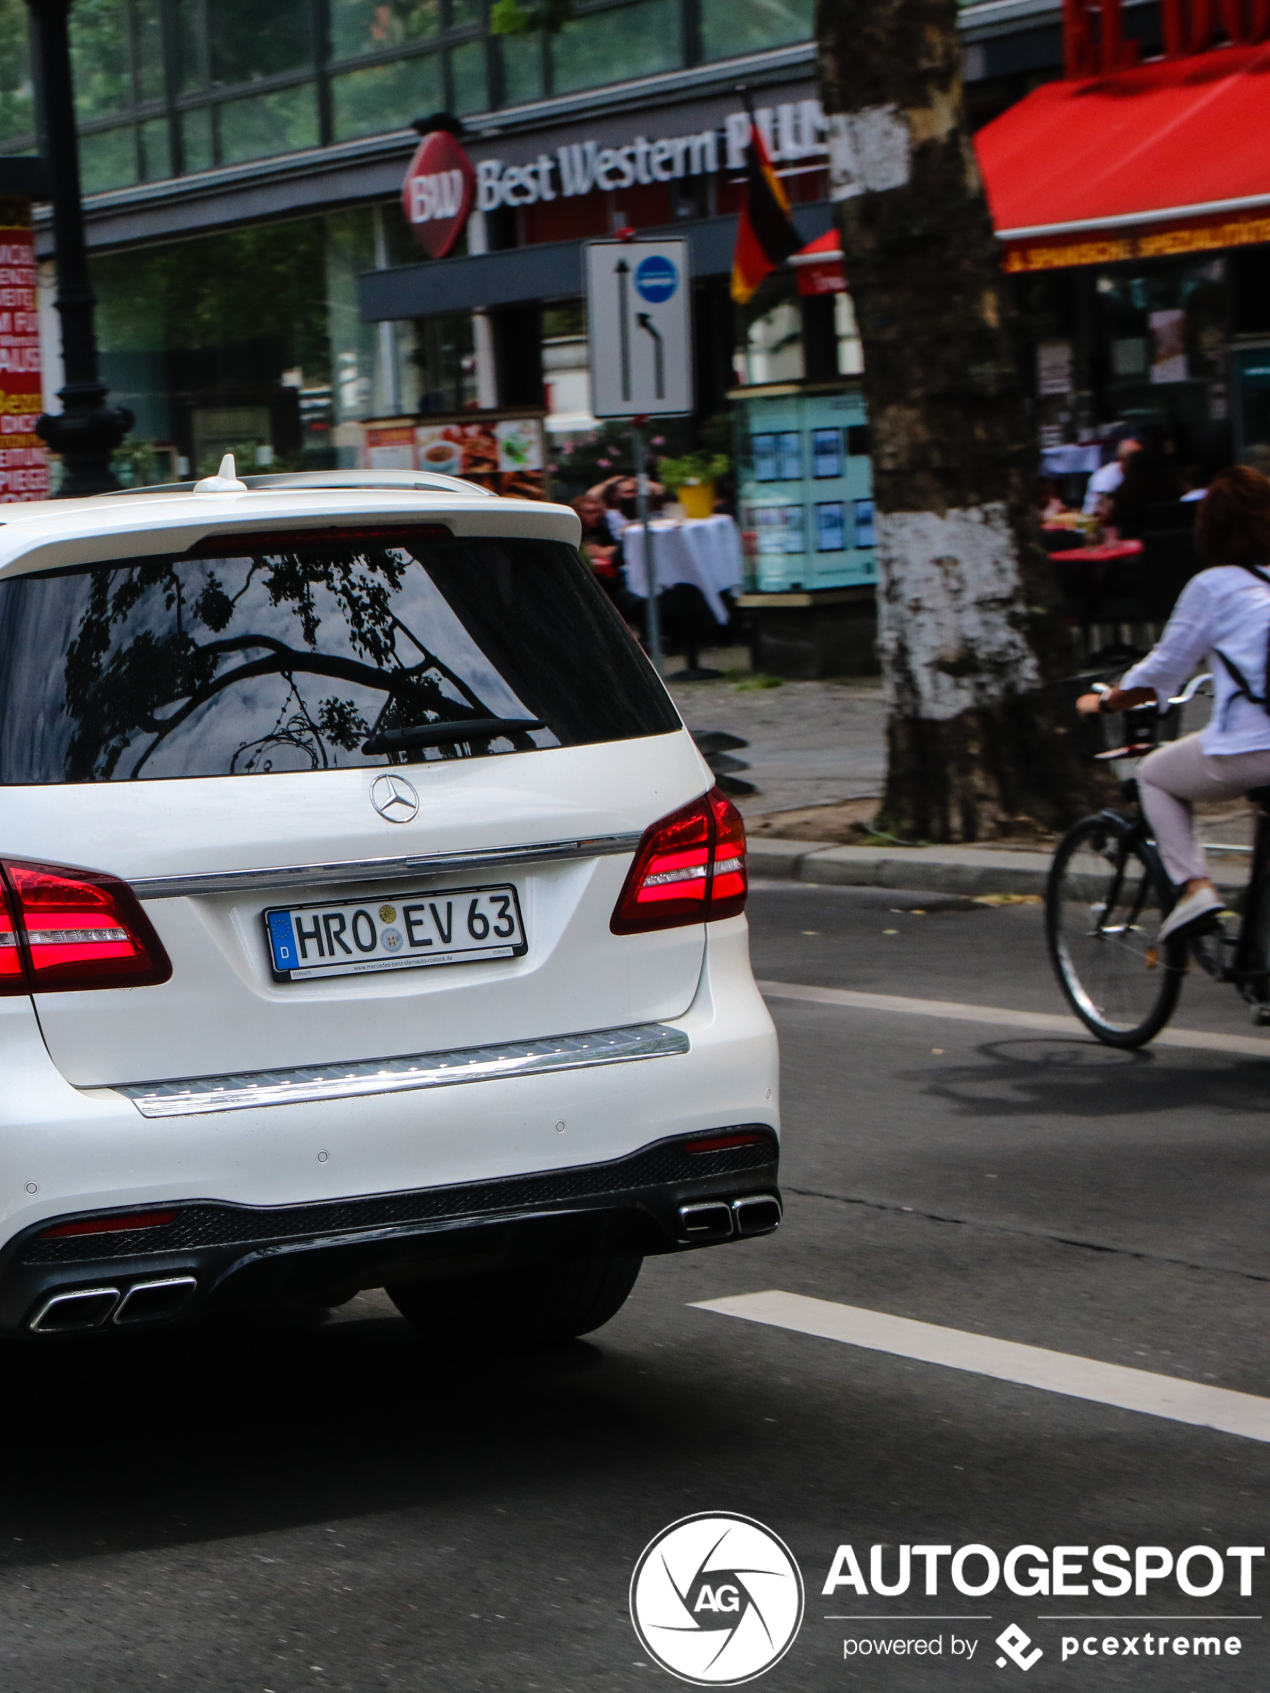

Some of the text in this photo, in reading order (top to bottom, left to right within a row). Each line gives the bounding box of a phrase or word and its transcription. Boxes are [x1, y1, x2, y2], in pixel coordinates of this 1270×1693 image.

[477, 154, 556, 211] Best
[558, 131, 718, 196] Western
[280, 946, 290, 959] D
[294, 895, 515, 958] HRO EV 63
